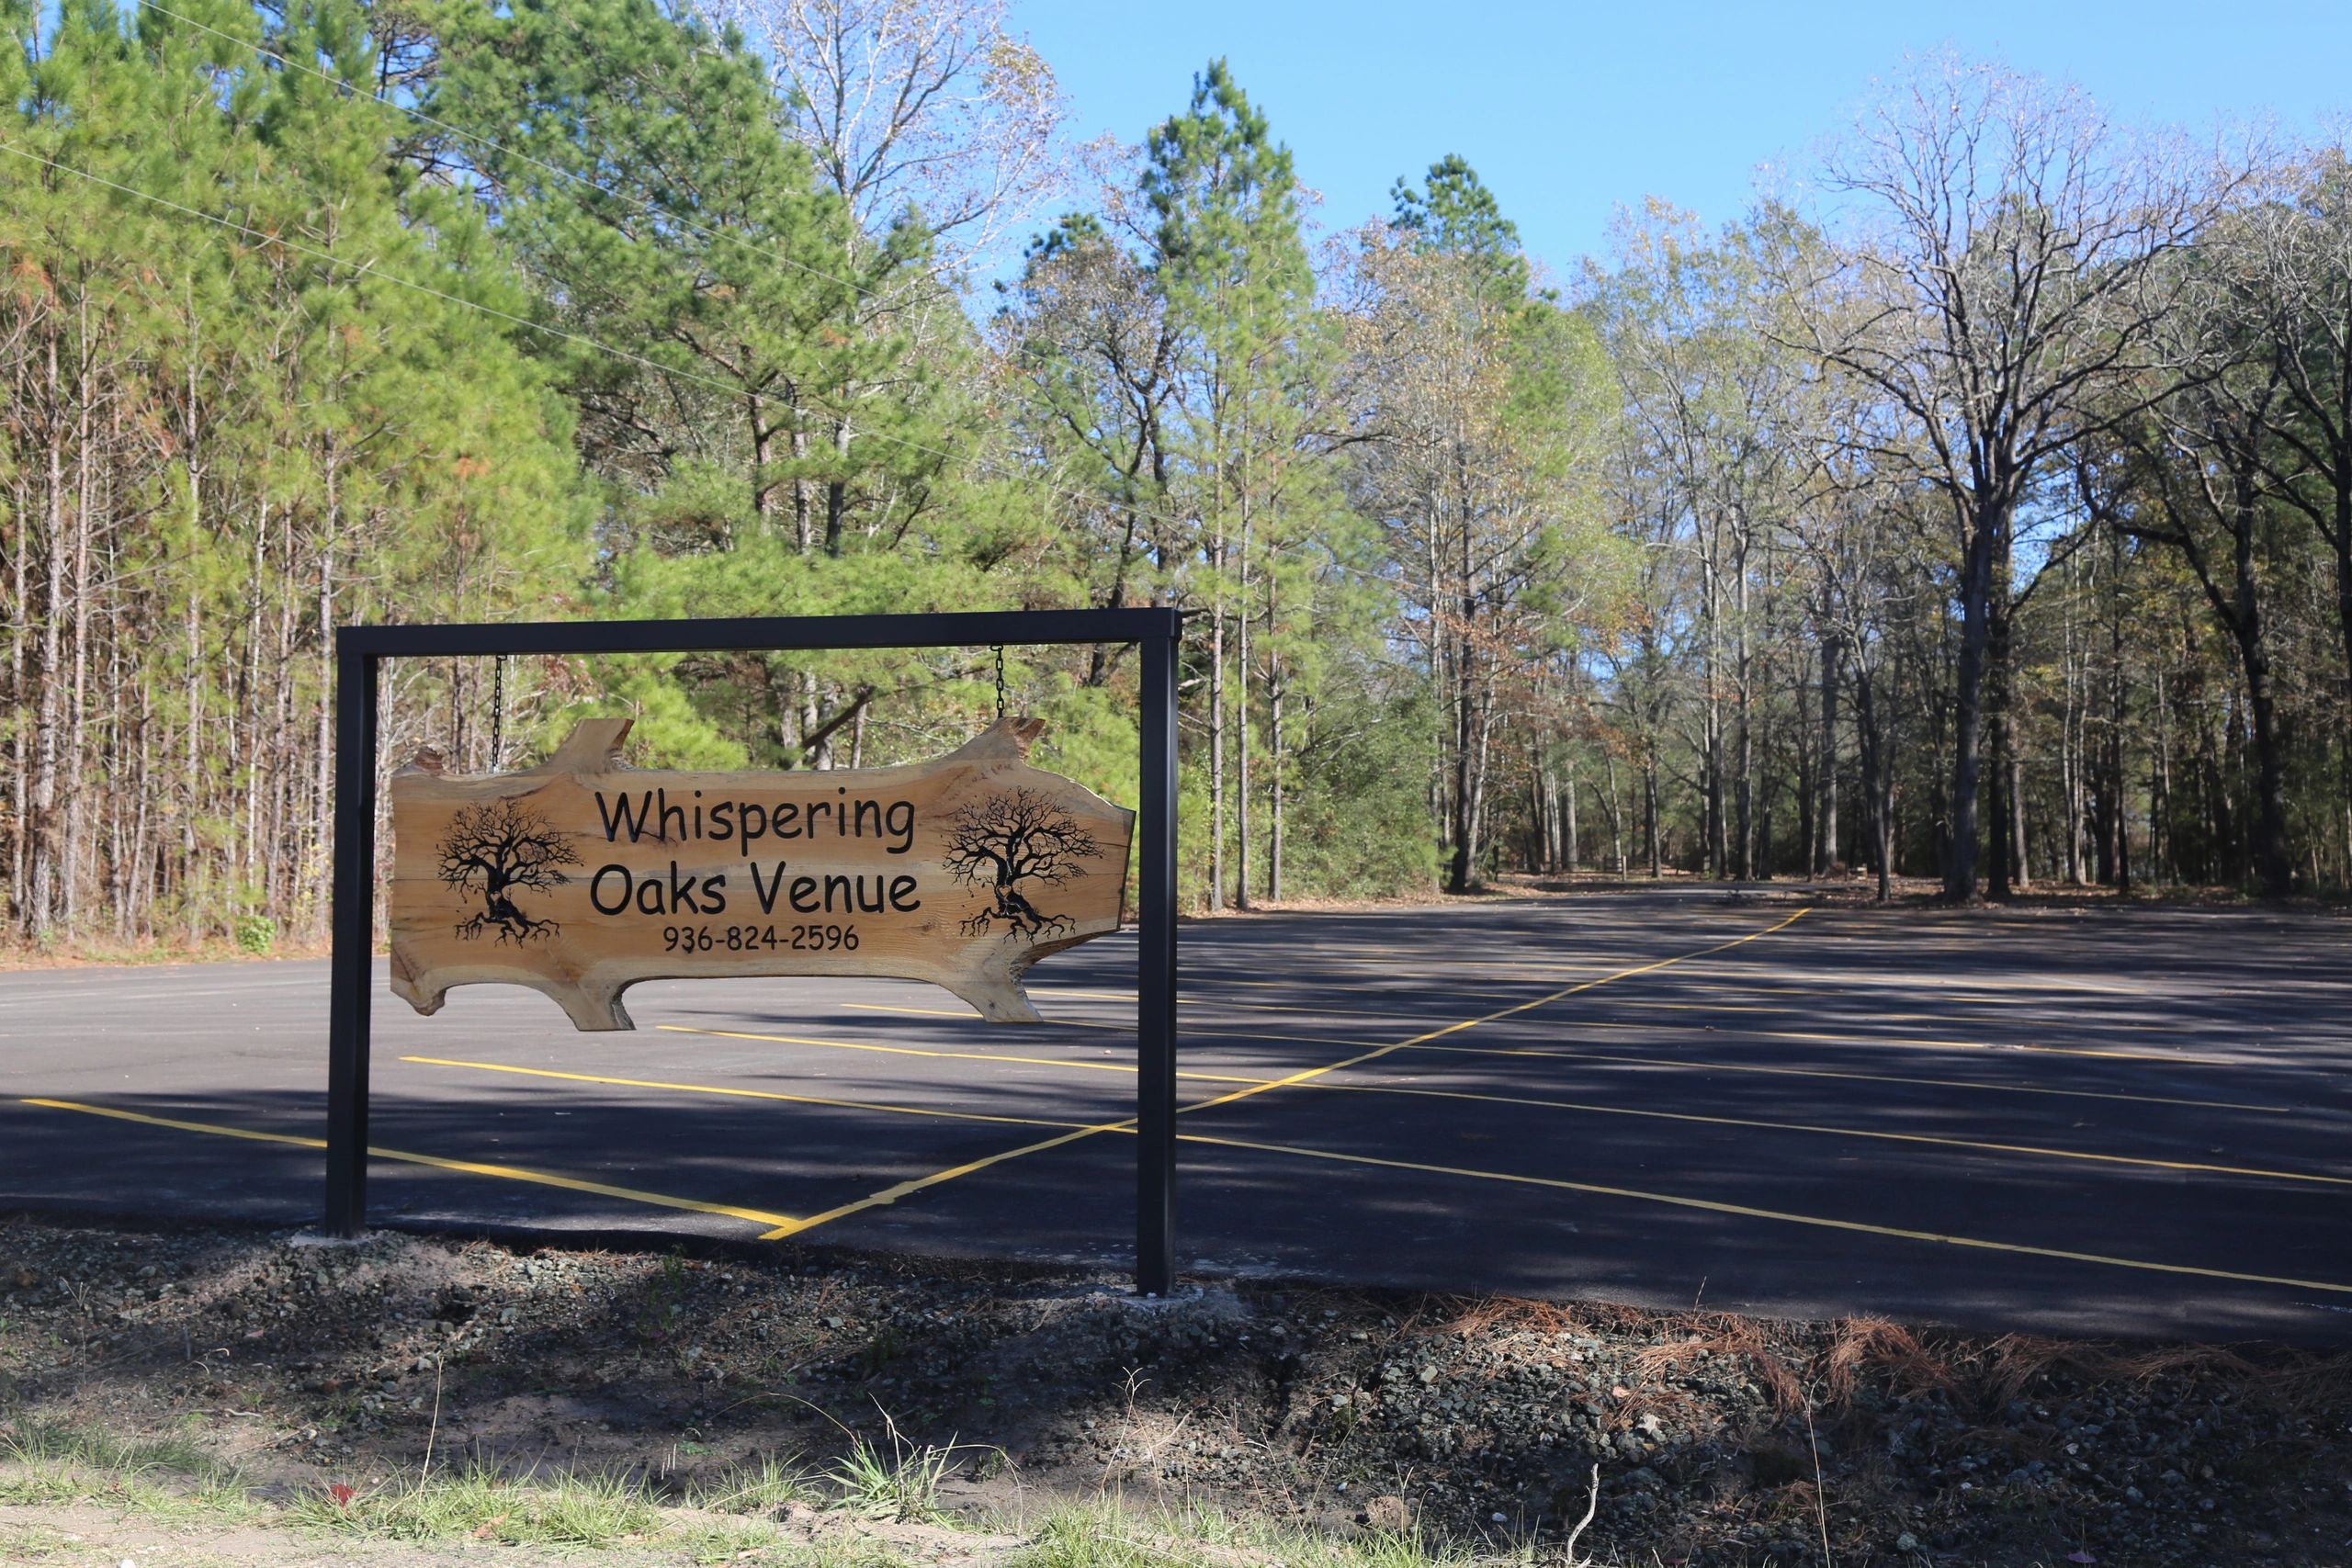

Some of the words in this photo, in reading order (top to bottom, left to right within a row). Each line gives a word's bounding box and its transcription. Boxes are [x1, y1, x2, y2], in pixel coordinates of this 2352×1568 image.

[594, 786, 916, 859] Whispering
[590, 860, 728, 917] Oaks
[749, 860, 922, 916] Venue
[662, 923, 860, 954] 936-824-2596
